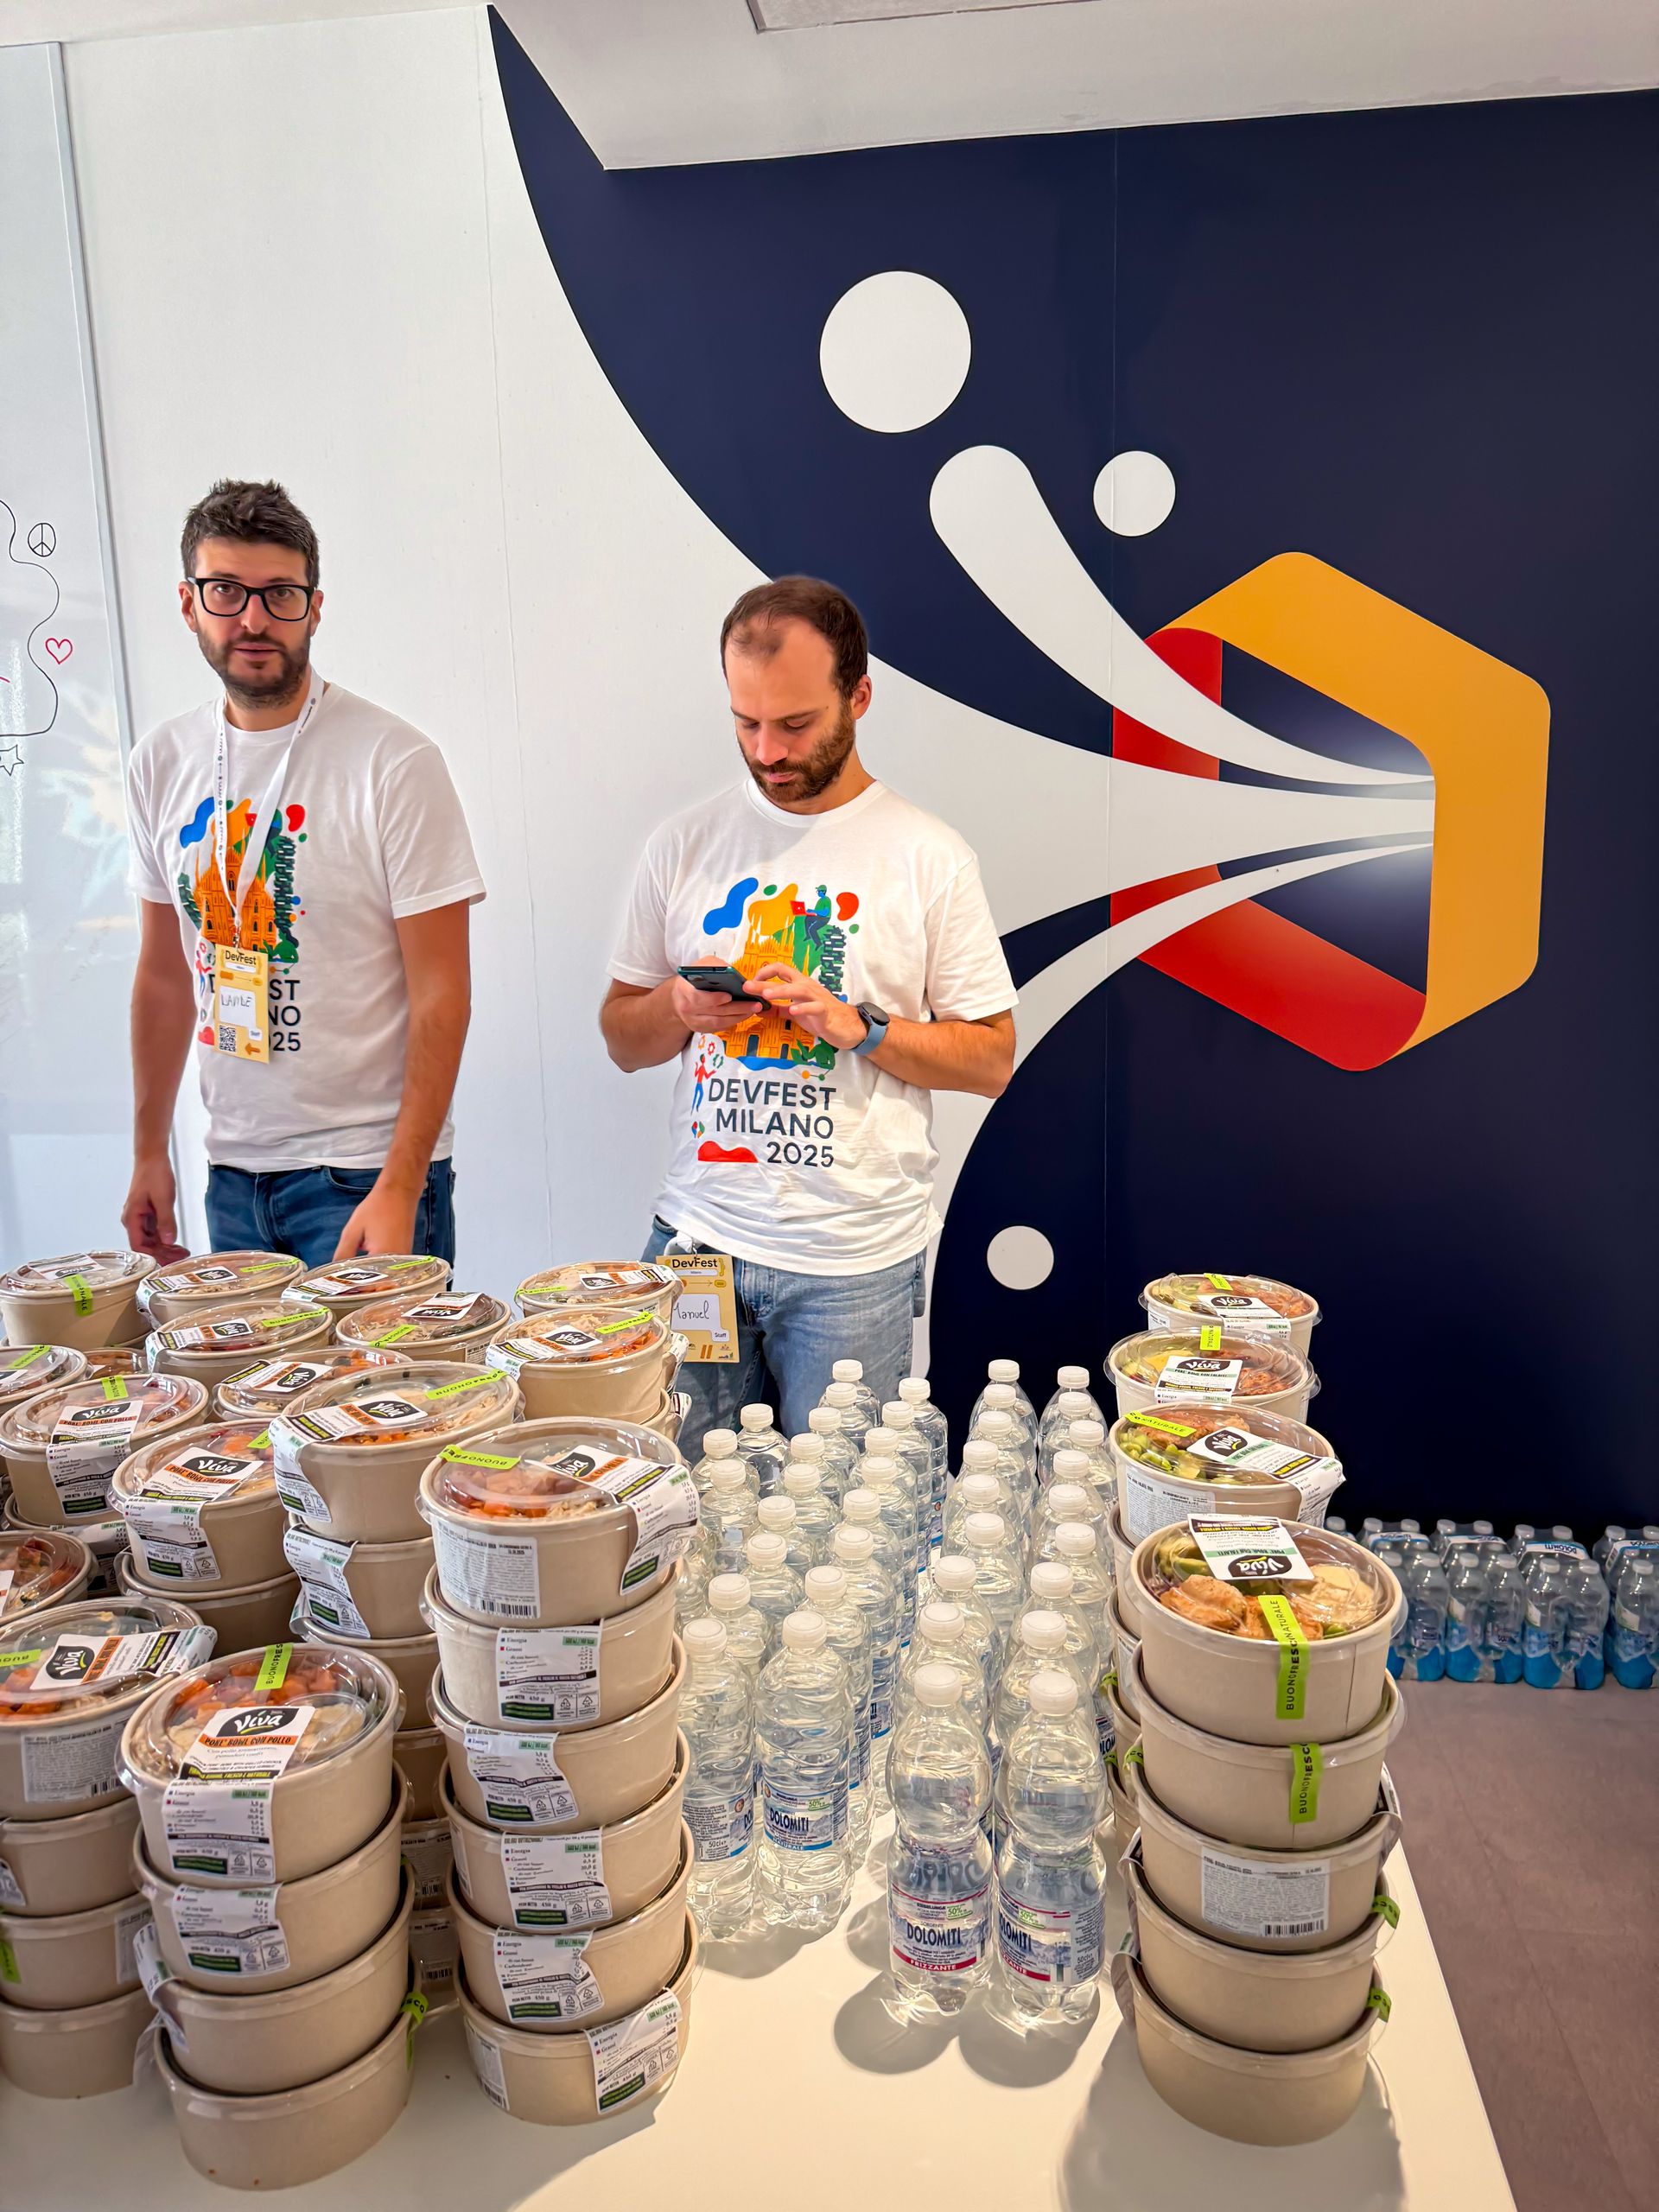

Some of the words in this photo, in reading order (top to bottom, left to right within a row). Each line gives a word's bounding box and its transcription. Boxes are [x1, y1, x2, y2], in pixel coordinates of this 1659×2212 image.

[225, 950, 257, 965] DevFest
[709, 1078, 836, 1110] DEVFEST
[716, 1108, 834, 1139] MILANO
[767, 1141, 834, 1167] 2025
[671, 1258, 718, 1268] DevFest
[1217, 1297, 1248, 1306] Viva
[1185, 1360, 1222, 1370] Viva
[84, 1406, 121, 1420] Viva
[1141, 1417, 1185, 1433] NATURALE
[1212, 1433, 1243, 1451] Viva
[198, 1459, 237, 1473] Viva
[1545, 1544, 1577, 1554] DOLOMITI
[1236, 1557, 1285, 1574] Viva
[1269, 1599, 1291, 1638] NATURALE
[266, 1643, 283, 1685] BUONOFRES
[234, 1710, 283, 1732] Viva
[251, 1736, 267, 1745] CON
[770, 1809, 809, 1832] DOLOMITI
[948, 1907, 962, 1916] 50%
[907, 1922, 961, 1946] DOLOMITI
[1000, 1911, 1033, 1951] OLOMITI
[910, 1959, 957, 1971] FRIZZANTE
[1077, 1954, 1089, 1963] 50cl
